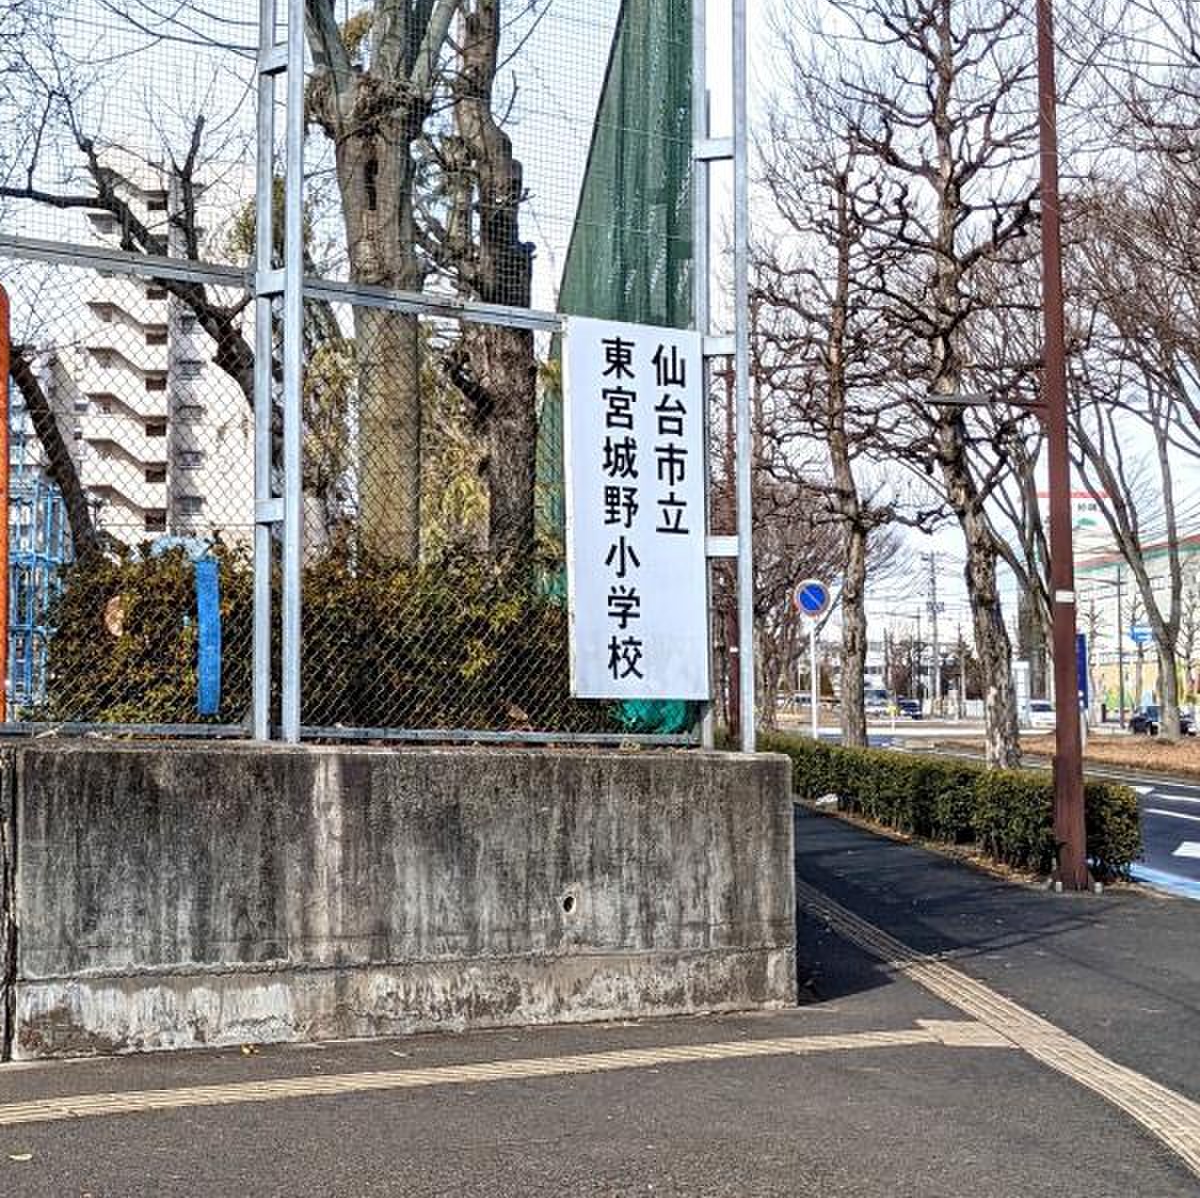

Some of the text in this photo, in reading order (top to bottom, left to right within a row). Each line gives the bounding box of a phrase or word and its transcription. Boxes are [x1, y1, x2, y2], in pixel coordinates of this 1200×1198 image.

[601, 336, 644, 681] 東宮城野小学校
[651, 343, 690, 535] 仙台市立
